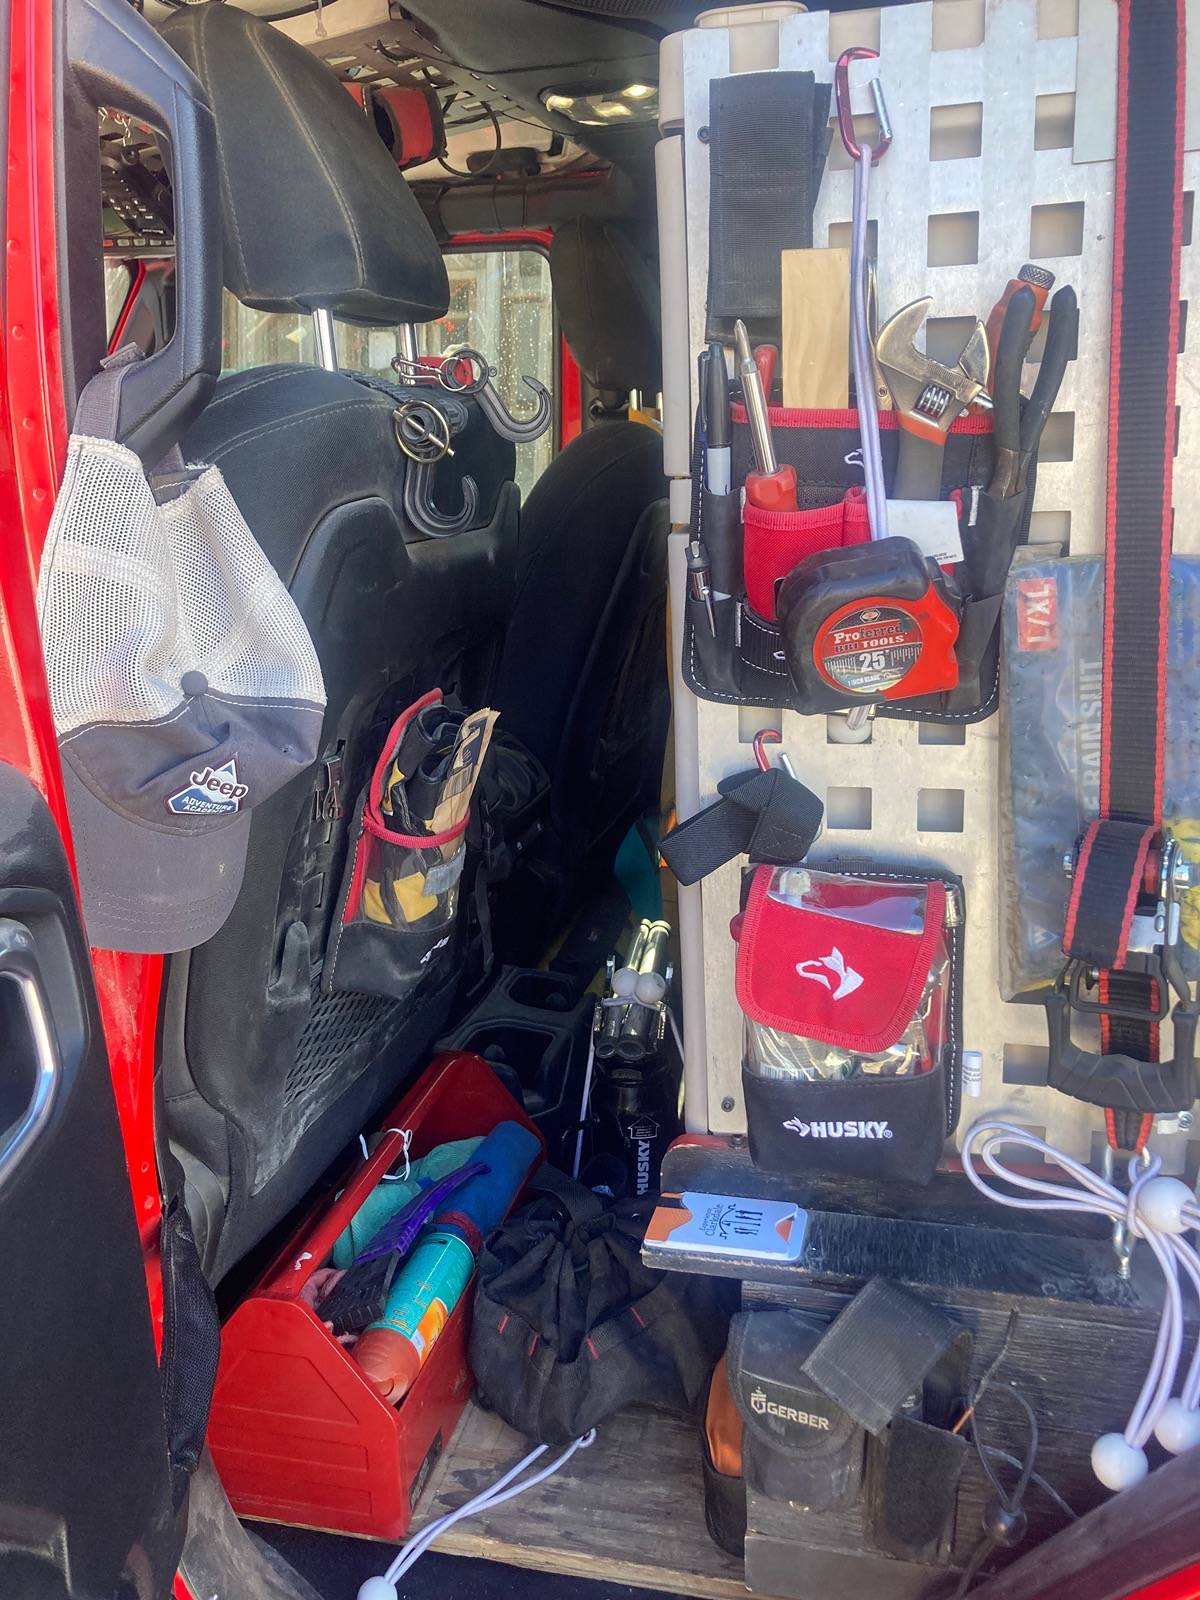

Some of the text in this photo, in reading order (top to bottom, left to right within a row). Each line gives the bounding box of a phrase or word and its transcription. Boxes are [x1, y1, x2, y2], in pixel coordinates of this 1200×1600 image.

[1026, 584, 1051, 643] L/XL
[834, 623, 904, 645] Proferred
[862, 635, 905, 648] TOOLS
[1079, 659, 1103, 718] SUIT
[1080, 723, 1101, 787] RAIN
[190, 767, 248, 799] Jeep
[182, 796, 234, 811] ADVENTURE
[637, 1140, 650, 1195] HUSKY
[767, 1402, 829, 1430] GERBER
